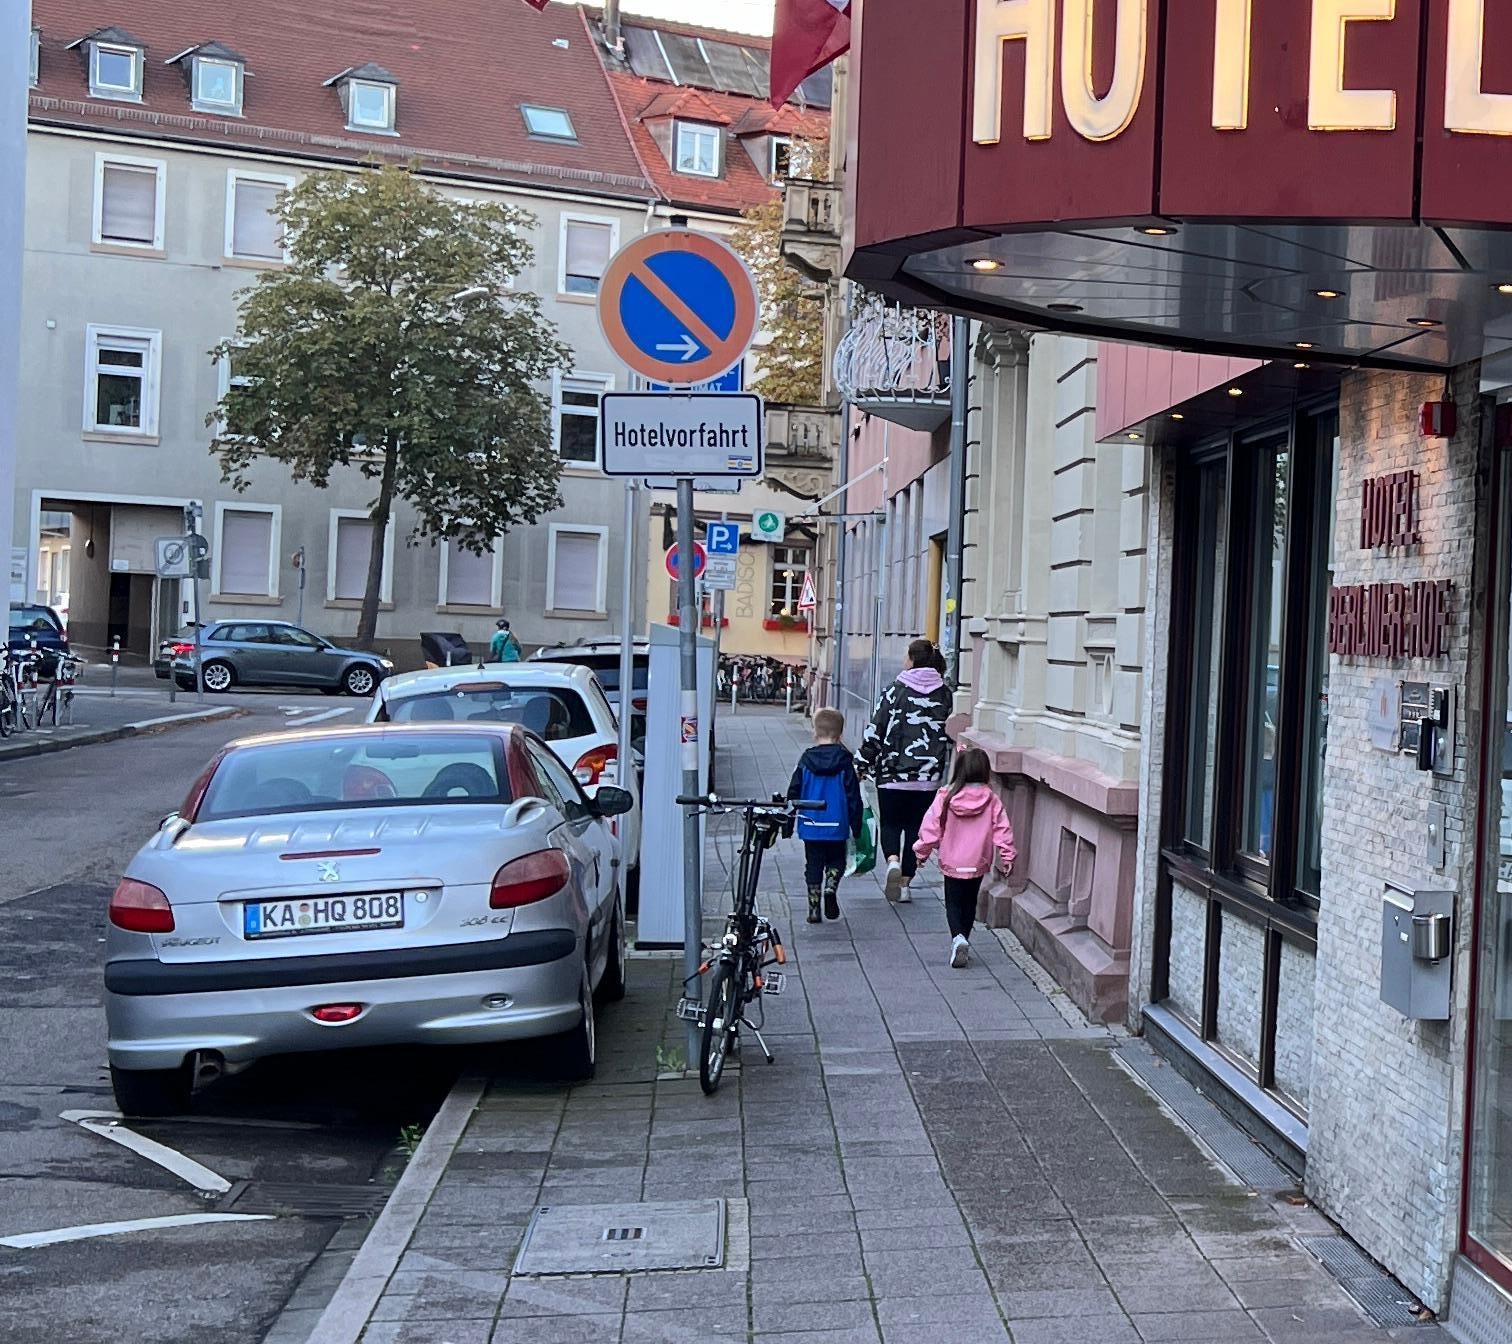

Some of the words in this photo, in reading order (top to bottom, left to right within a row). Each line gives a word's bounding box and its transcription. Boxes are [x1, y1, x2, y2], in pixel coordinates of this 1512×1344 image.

[614, 421, 748, 448] Hotelvorfahrt
[1360, 469, 1421, 549] HOTEL
[712, 526, 729, 550] P
[1329, 583, 1406, 656] BERLINER
[1408, 579, 1453, 657] HOF
[263, 904, 295, 928] KA
[313, 900, 346, 924] HQ
[353, 895, 399, 920] 808
